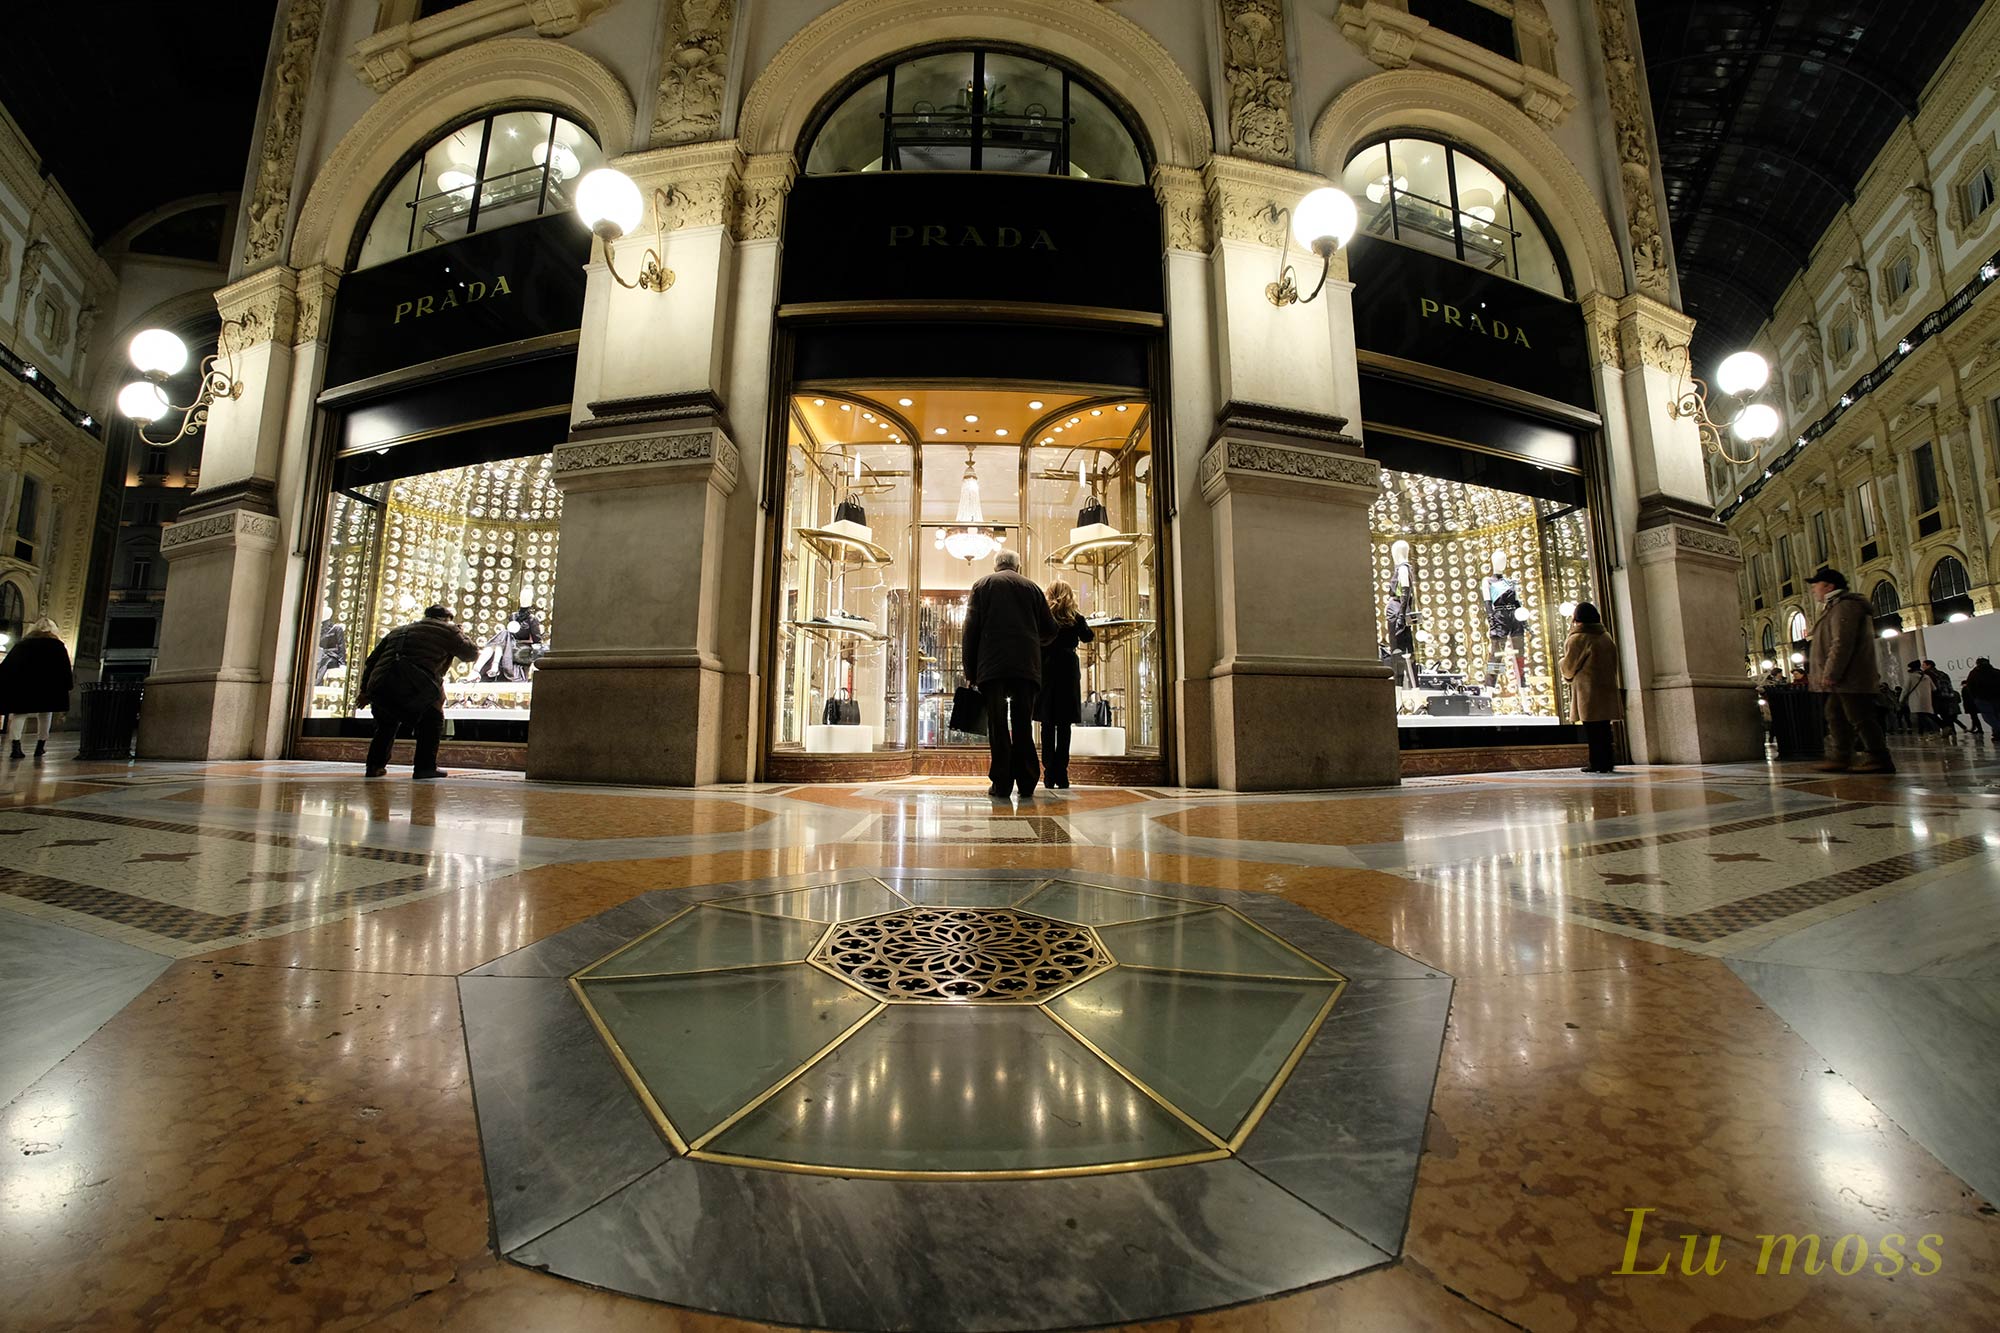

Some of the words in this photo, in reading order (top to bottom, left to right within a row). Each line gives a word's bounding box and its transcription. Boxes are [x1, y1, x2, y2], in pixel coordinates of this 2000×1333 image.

[888, 225, 1058, 250] PRADA
[393, 275, 512, 324] PRADA
[1421, 297, 1531, 349] PRADA
[1947, 655, 1990, 671] GUC
